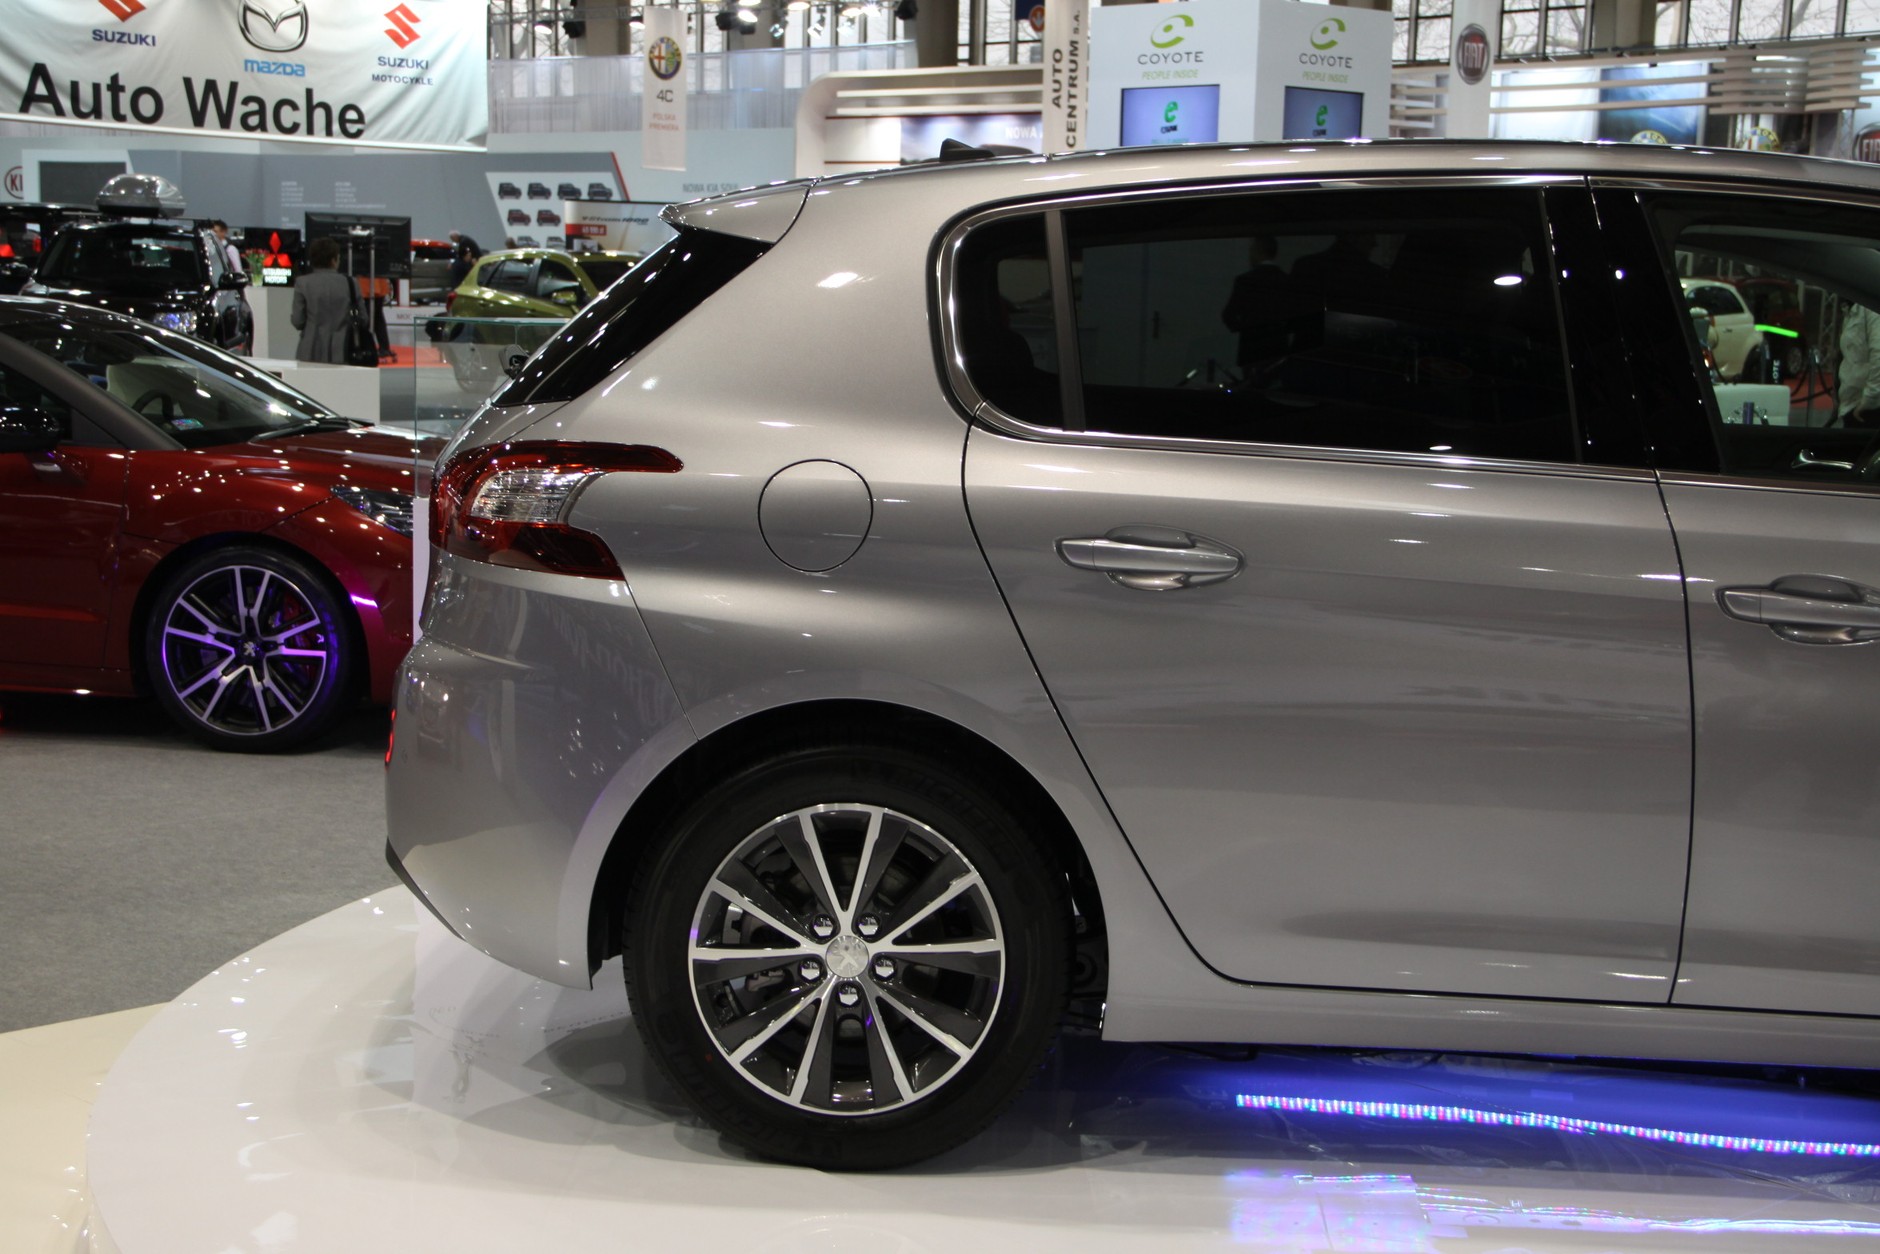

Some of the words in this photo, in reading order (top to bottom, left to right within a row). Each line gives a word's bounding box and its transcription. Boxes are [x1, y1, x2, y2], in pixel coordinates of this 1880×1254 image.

[92, 28, 156, 47] SUZUKI
[378, 56, 429, 70] SUZUKI
[1137, 51, 1204, 65] COYOTE
[1299, 53, 1353, 69] COYOTE
[1464, 42, 1485, 68] FIAT
[372, 73, 434, 86] MOTOCYKLE
[1052, 48, 1063, 109] AUTO
[18, 62, 164, 126] Auto
[183, 76, 366, 139] Wache
[656, 89, 674, 103] 4C
[1066, 40, 1079, 149] CENTRUM
[1005, 126, 1037, 140] NOWA
[10, 174, 23, 192] KI
